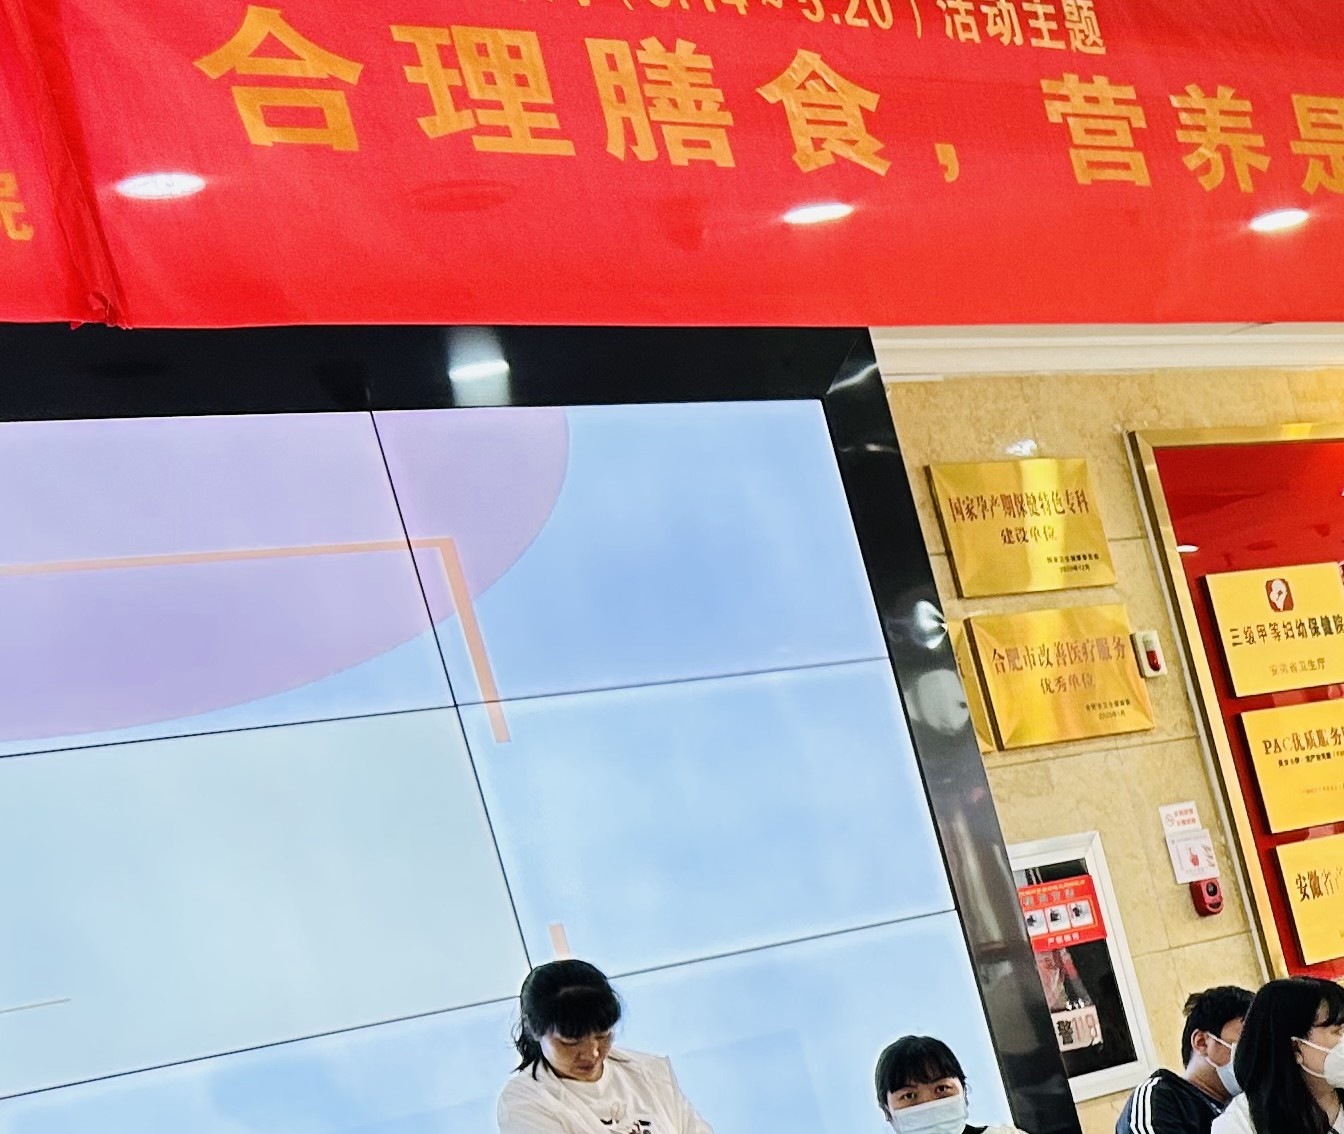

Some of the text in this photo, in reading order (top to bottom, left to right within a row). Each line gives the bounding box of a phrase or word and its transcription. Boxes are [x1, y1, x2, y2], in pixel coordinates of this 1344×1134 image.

[990, 634, 1126, 675] 合肥市改善医疗服务
